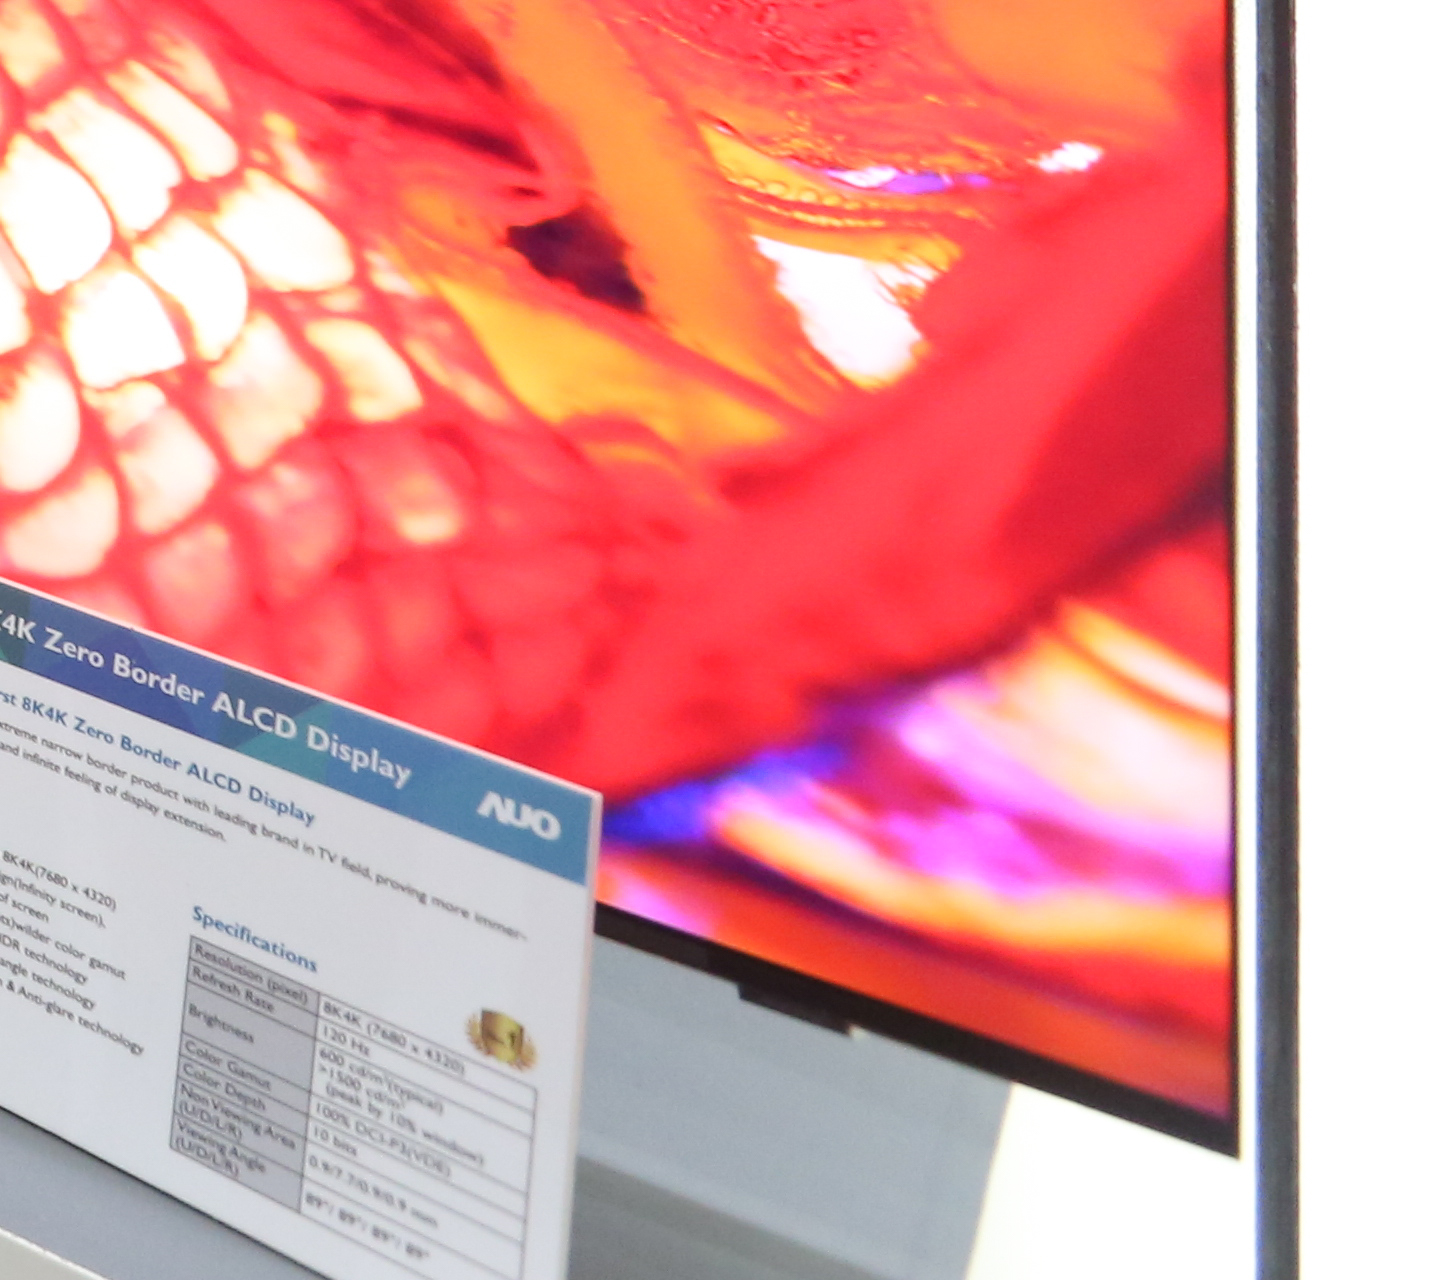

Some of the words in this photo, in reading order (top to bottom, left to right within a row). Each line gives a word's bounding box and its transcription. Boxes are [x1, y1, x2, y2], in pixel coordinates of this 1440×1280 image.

[44, 627, 105, 668] Zero
[113, 653, 205, 705] Border
[211, 692, 298, 739] ALCD
[307, 724, 412, 789] Display
[0, 741, 20, 757] and
[23, 749, 61, 774] infinite
[64, 766, 102, 793] feeling
[105, 783, 117, 797] of
[121, 790, 160, 816] display
[22, 697, 69, 727] 8K4K
[74, 716, 114, 744] Zero
[120, 735, 182, 771] Border
[187, 763, 242, 794] ALCD
[249, 785, 316, 827] Display
[41, 737, 83, 761] narrow
[86, 753, 127, 779] border
[130, 774, 179, 801] product
[183, 794, 210, 812] with
[214, 805, 257, 835] leading
[261, 823, 299, 850] brand
[318, 846, 338, 863] TV
[375, 873, 428, 906] proving
[431, 896, 470, 920] more
[476, 790, 562, 840] AUO
[11, 897, 50, 923] screen
[55, 940, 86, 961] color
[89, 957, 127, 981] gamut
[192, 905, 317, 973] Specifications
[195, 943, 264, 984] Resolution
[0, 956, 28, 978] angle
[31, 972, 96, 1011] technology
[24, 948, 89, 986] technology
[78, 1015, 145, 1056] technology
